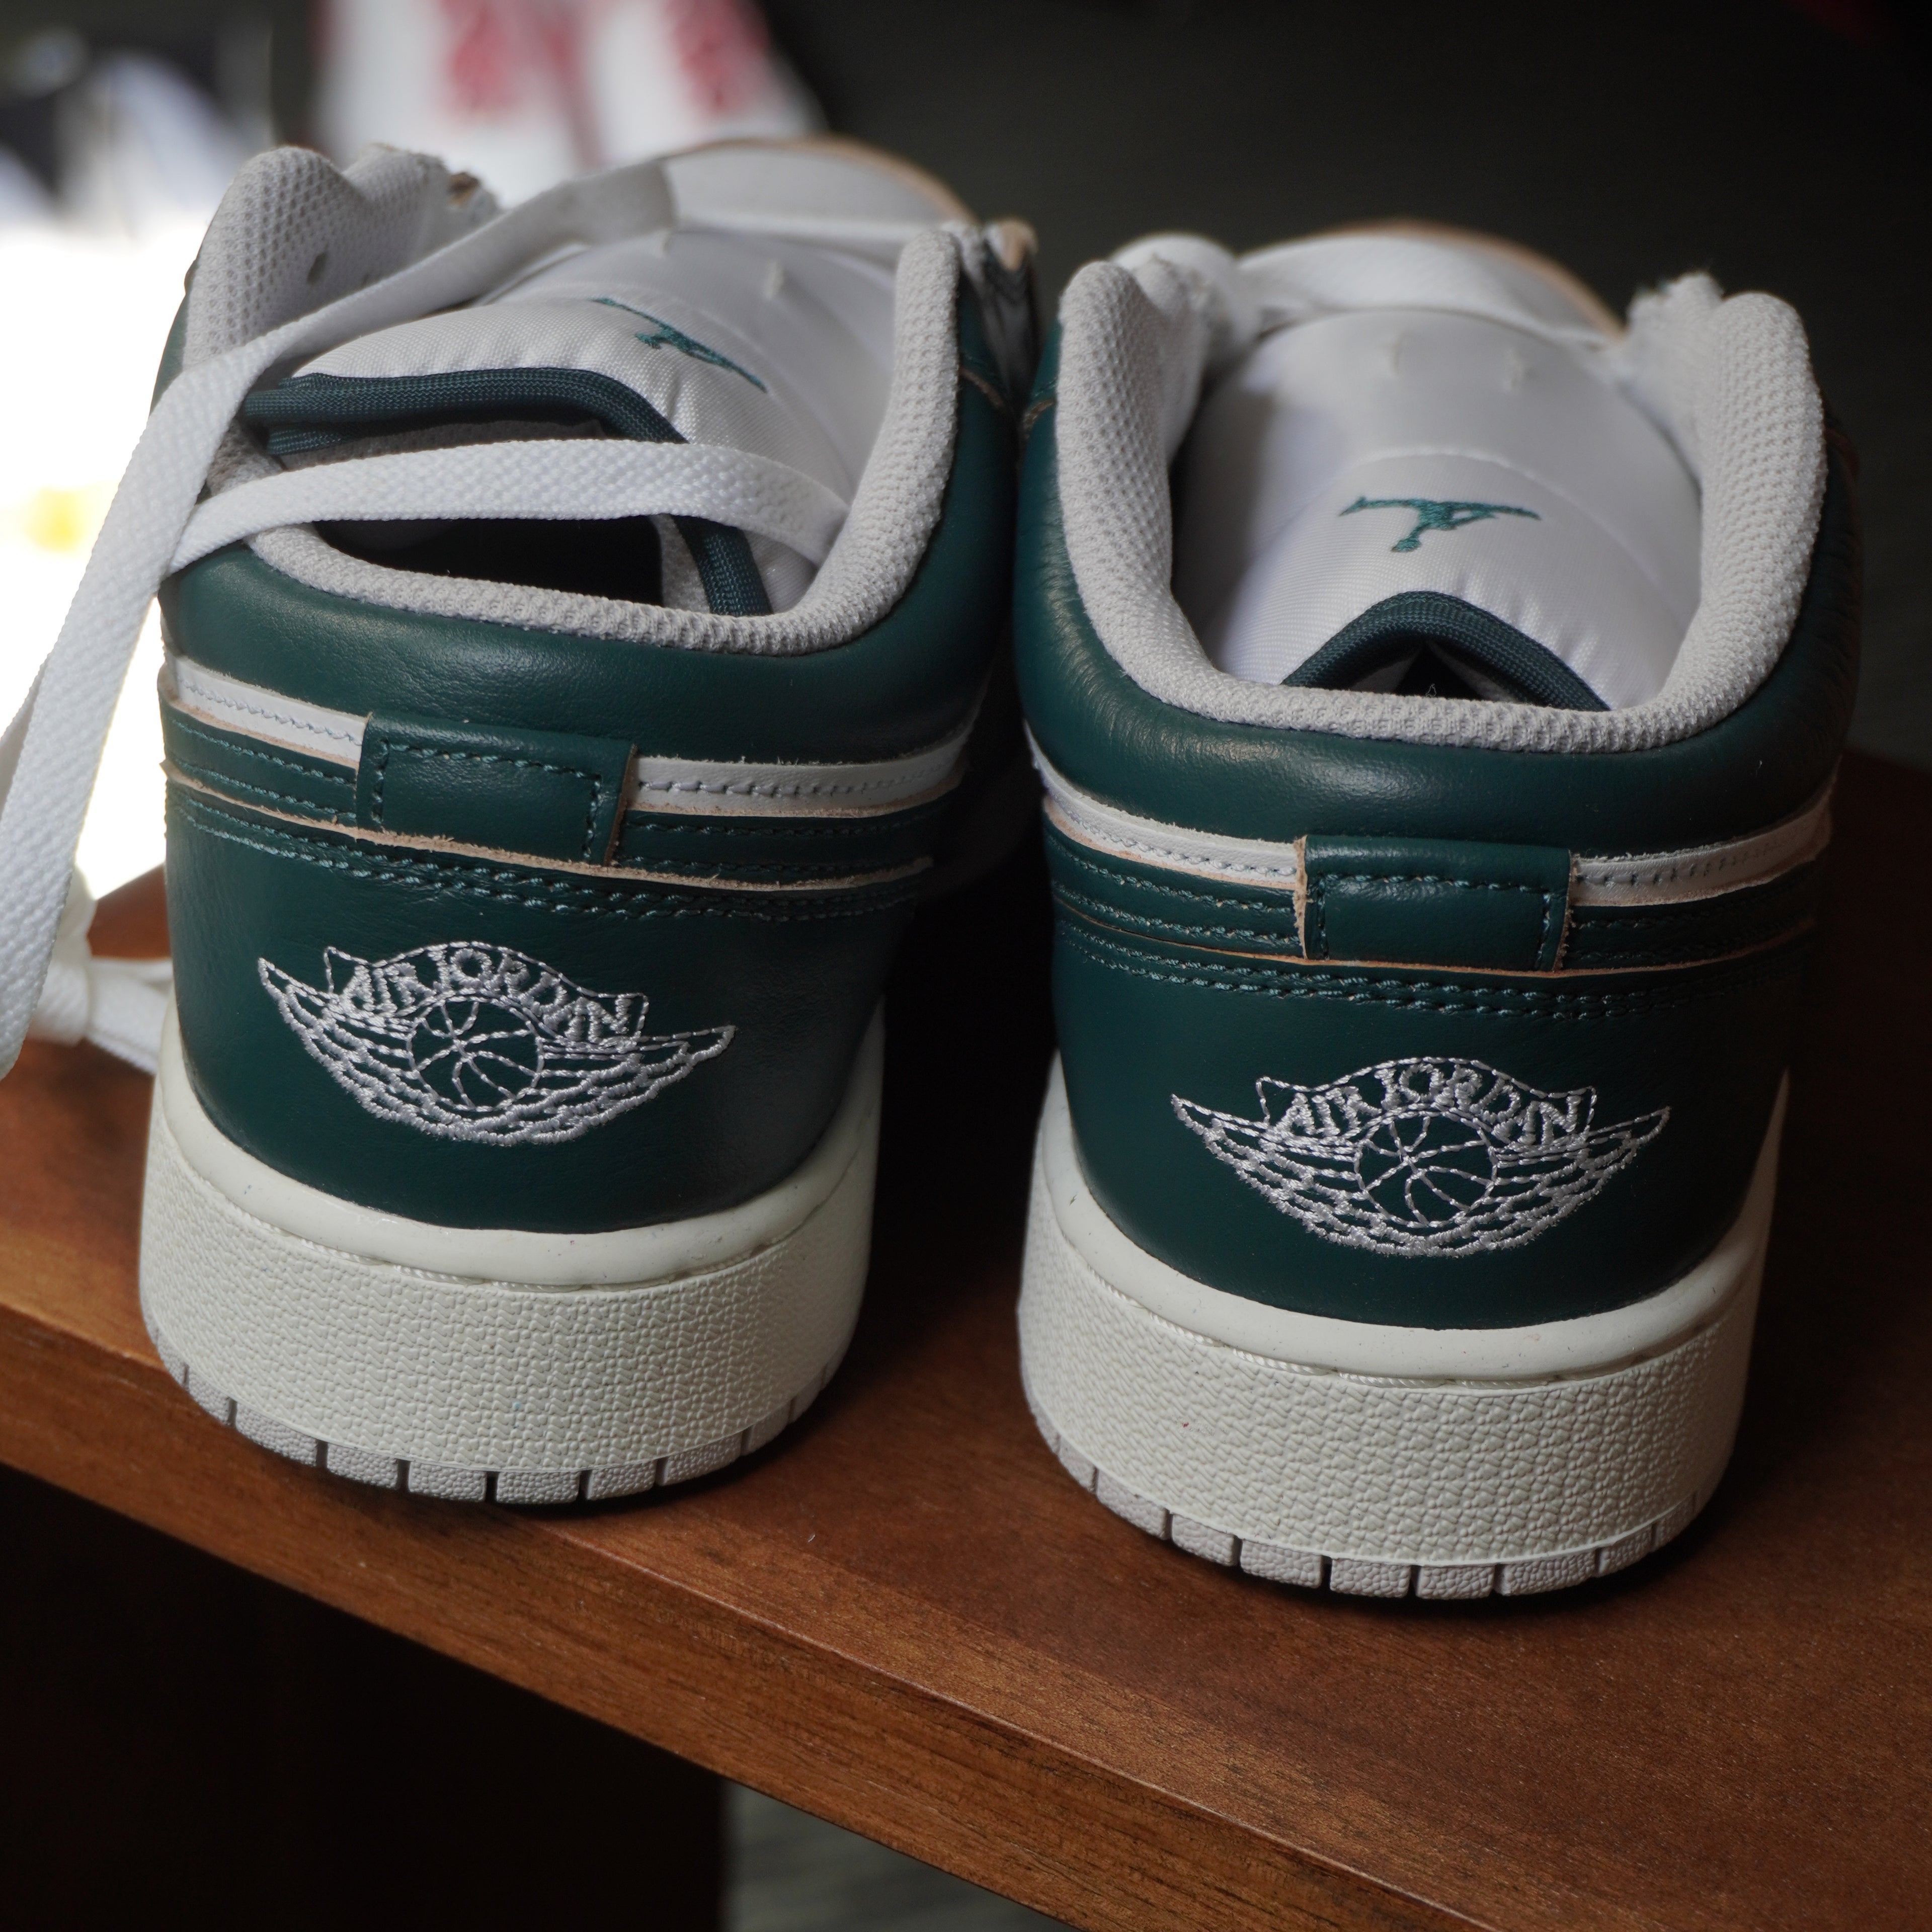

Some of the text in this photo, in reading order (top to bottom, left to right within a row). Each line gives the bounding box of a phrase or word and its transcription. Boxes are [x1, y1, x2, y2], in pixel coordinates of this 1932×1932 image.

[338, 948, 631, 1043] AIR JORDAN
[1273, 1064, 1581, 1145] AIR JORDAN
